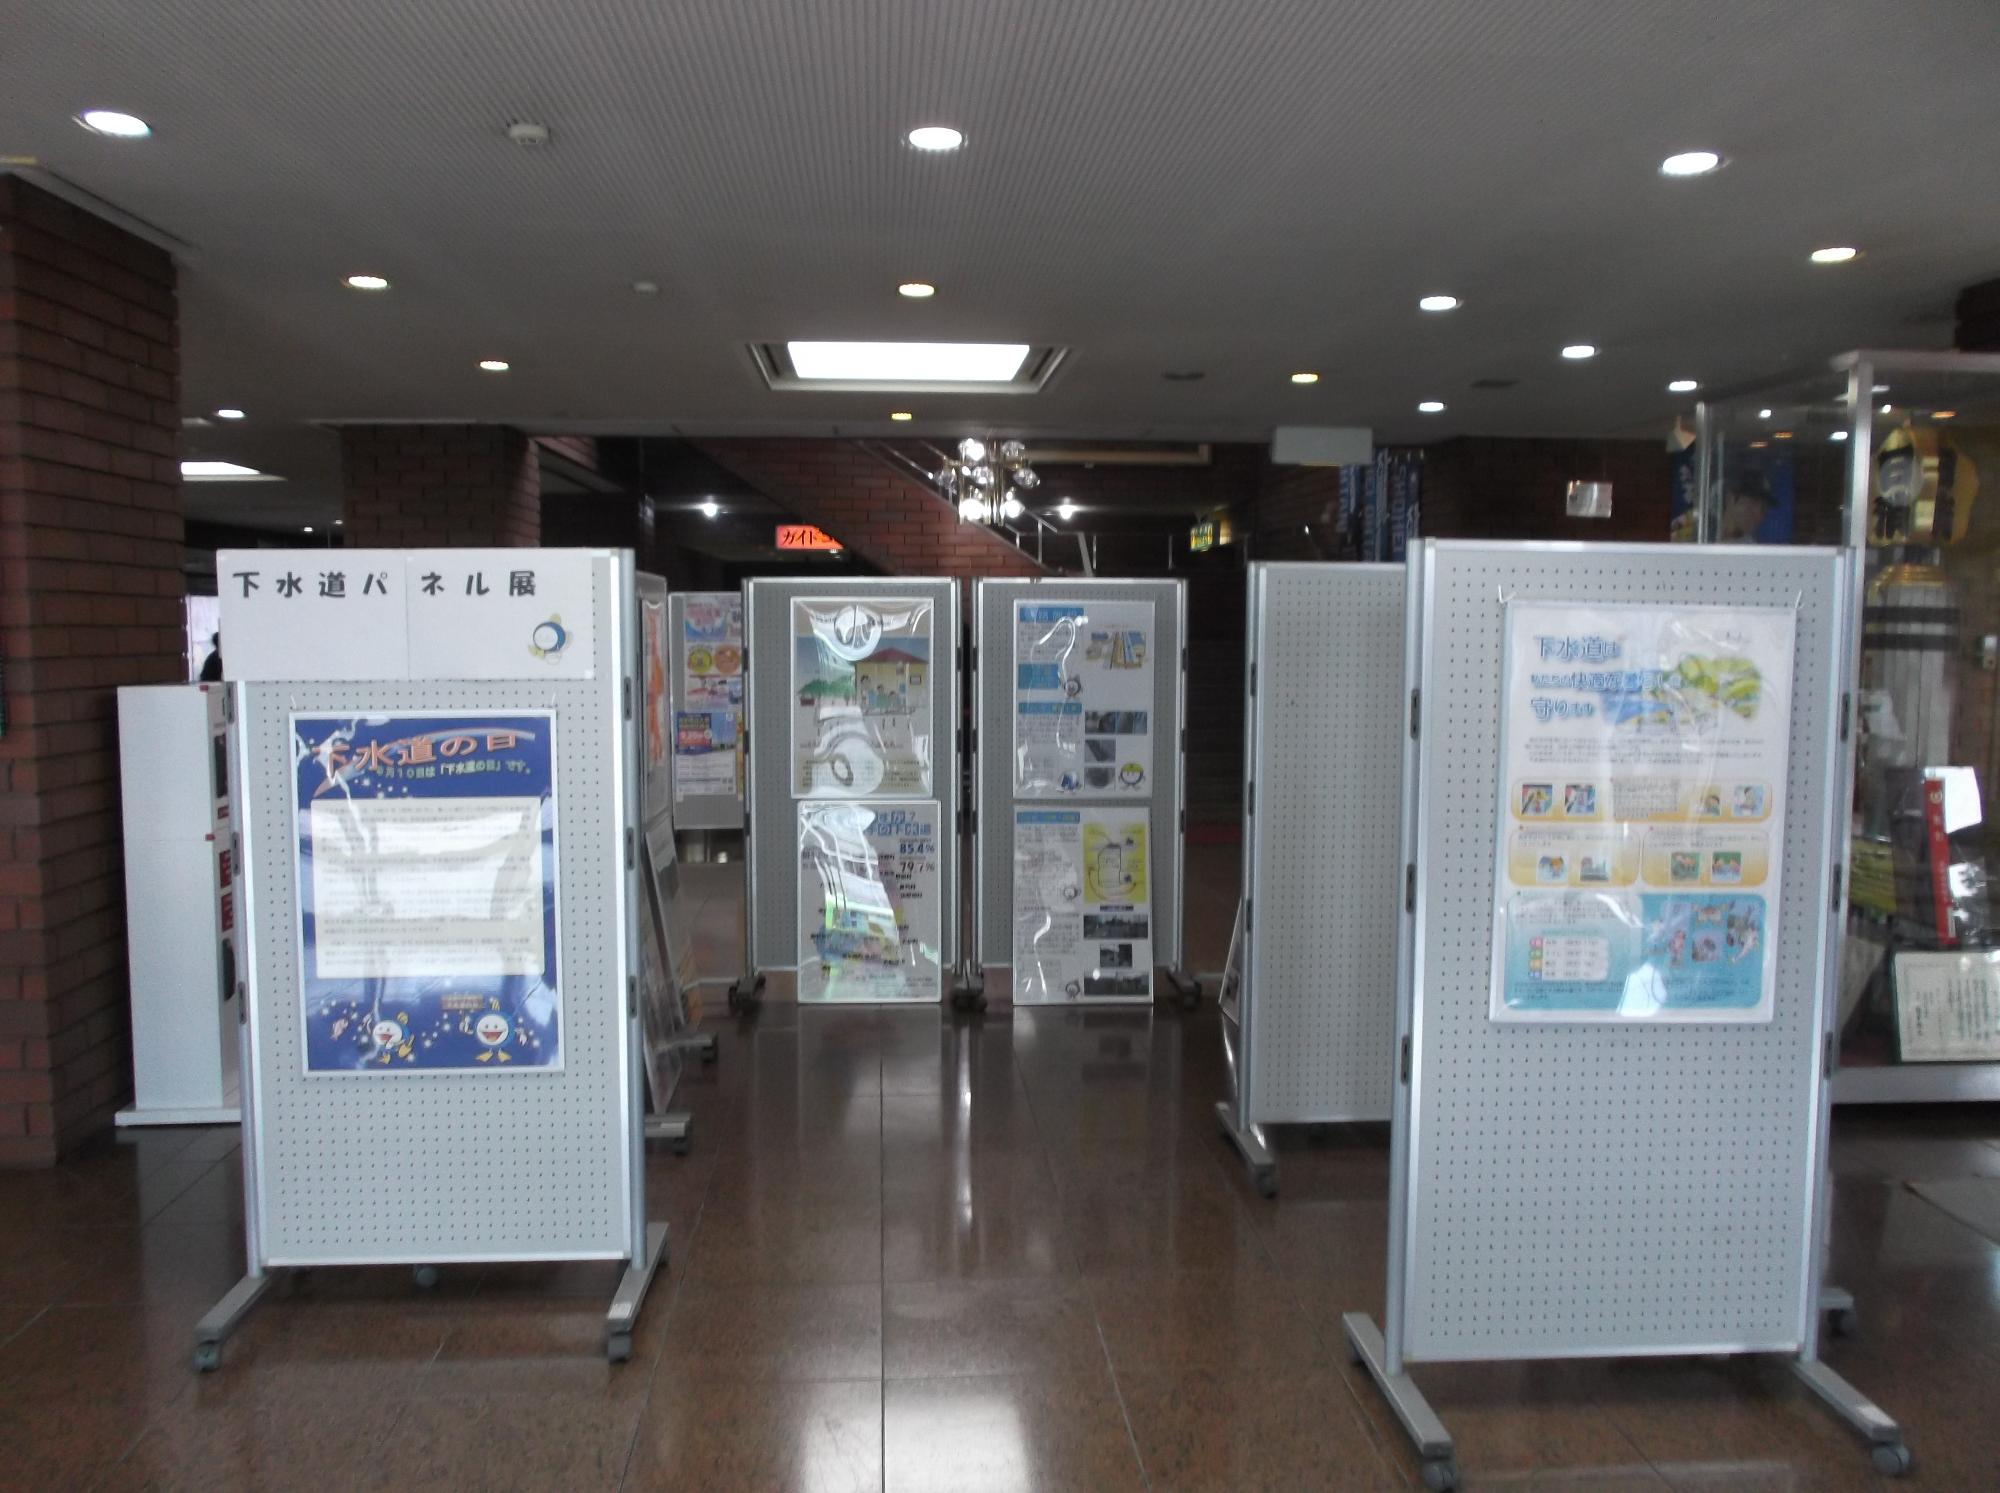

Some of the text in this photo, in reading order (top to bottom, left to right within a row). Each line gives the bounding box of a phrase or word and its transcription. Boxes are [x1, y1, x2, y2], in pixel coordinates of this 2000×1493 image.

[232, 570, 536, 598] 下水道パネル展
[1534, 636, 1621, 661] 下水道は
[313, 735, 517, 779] 下水道の日
